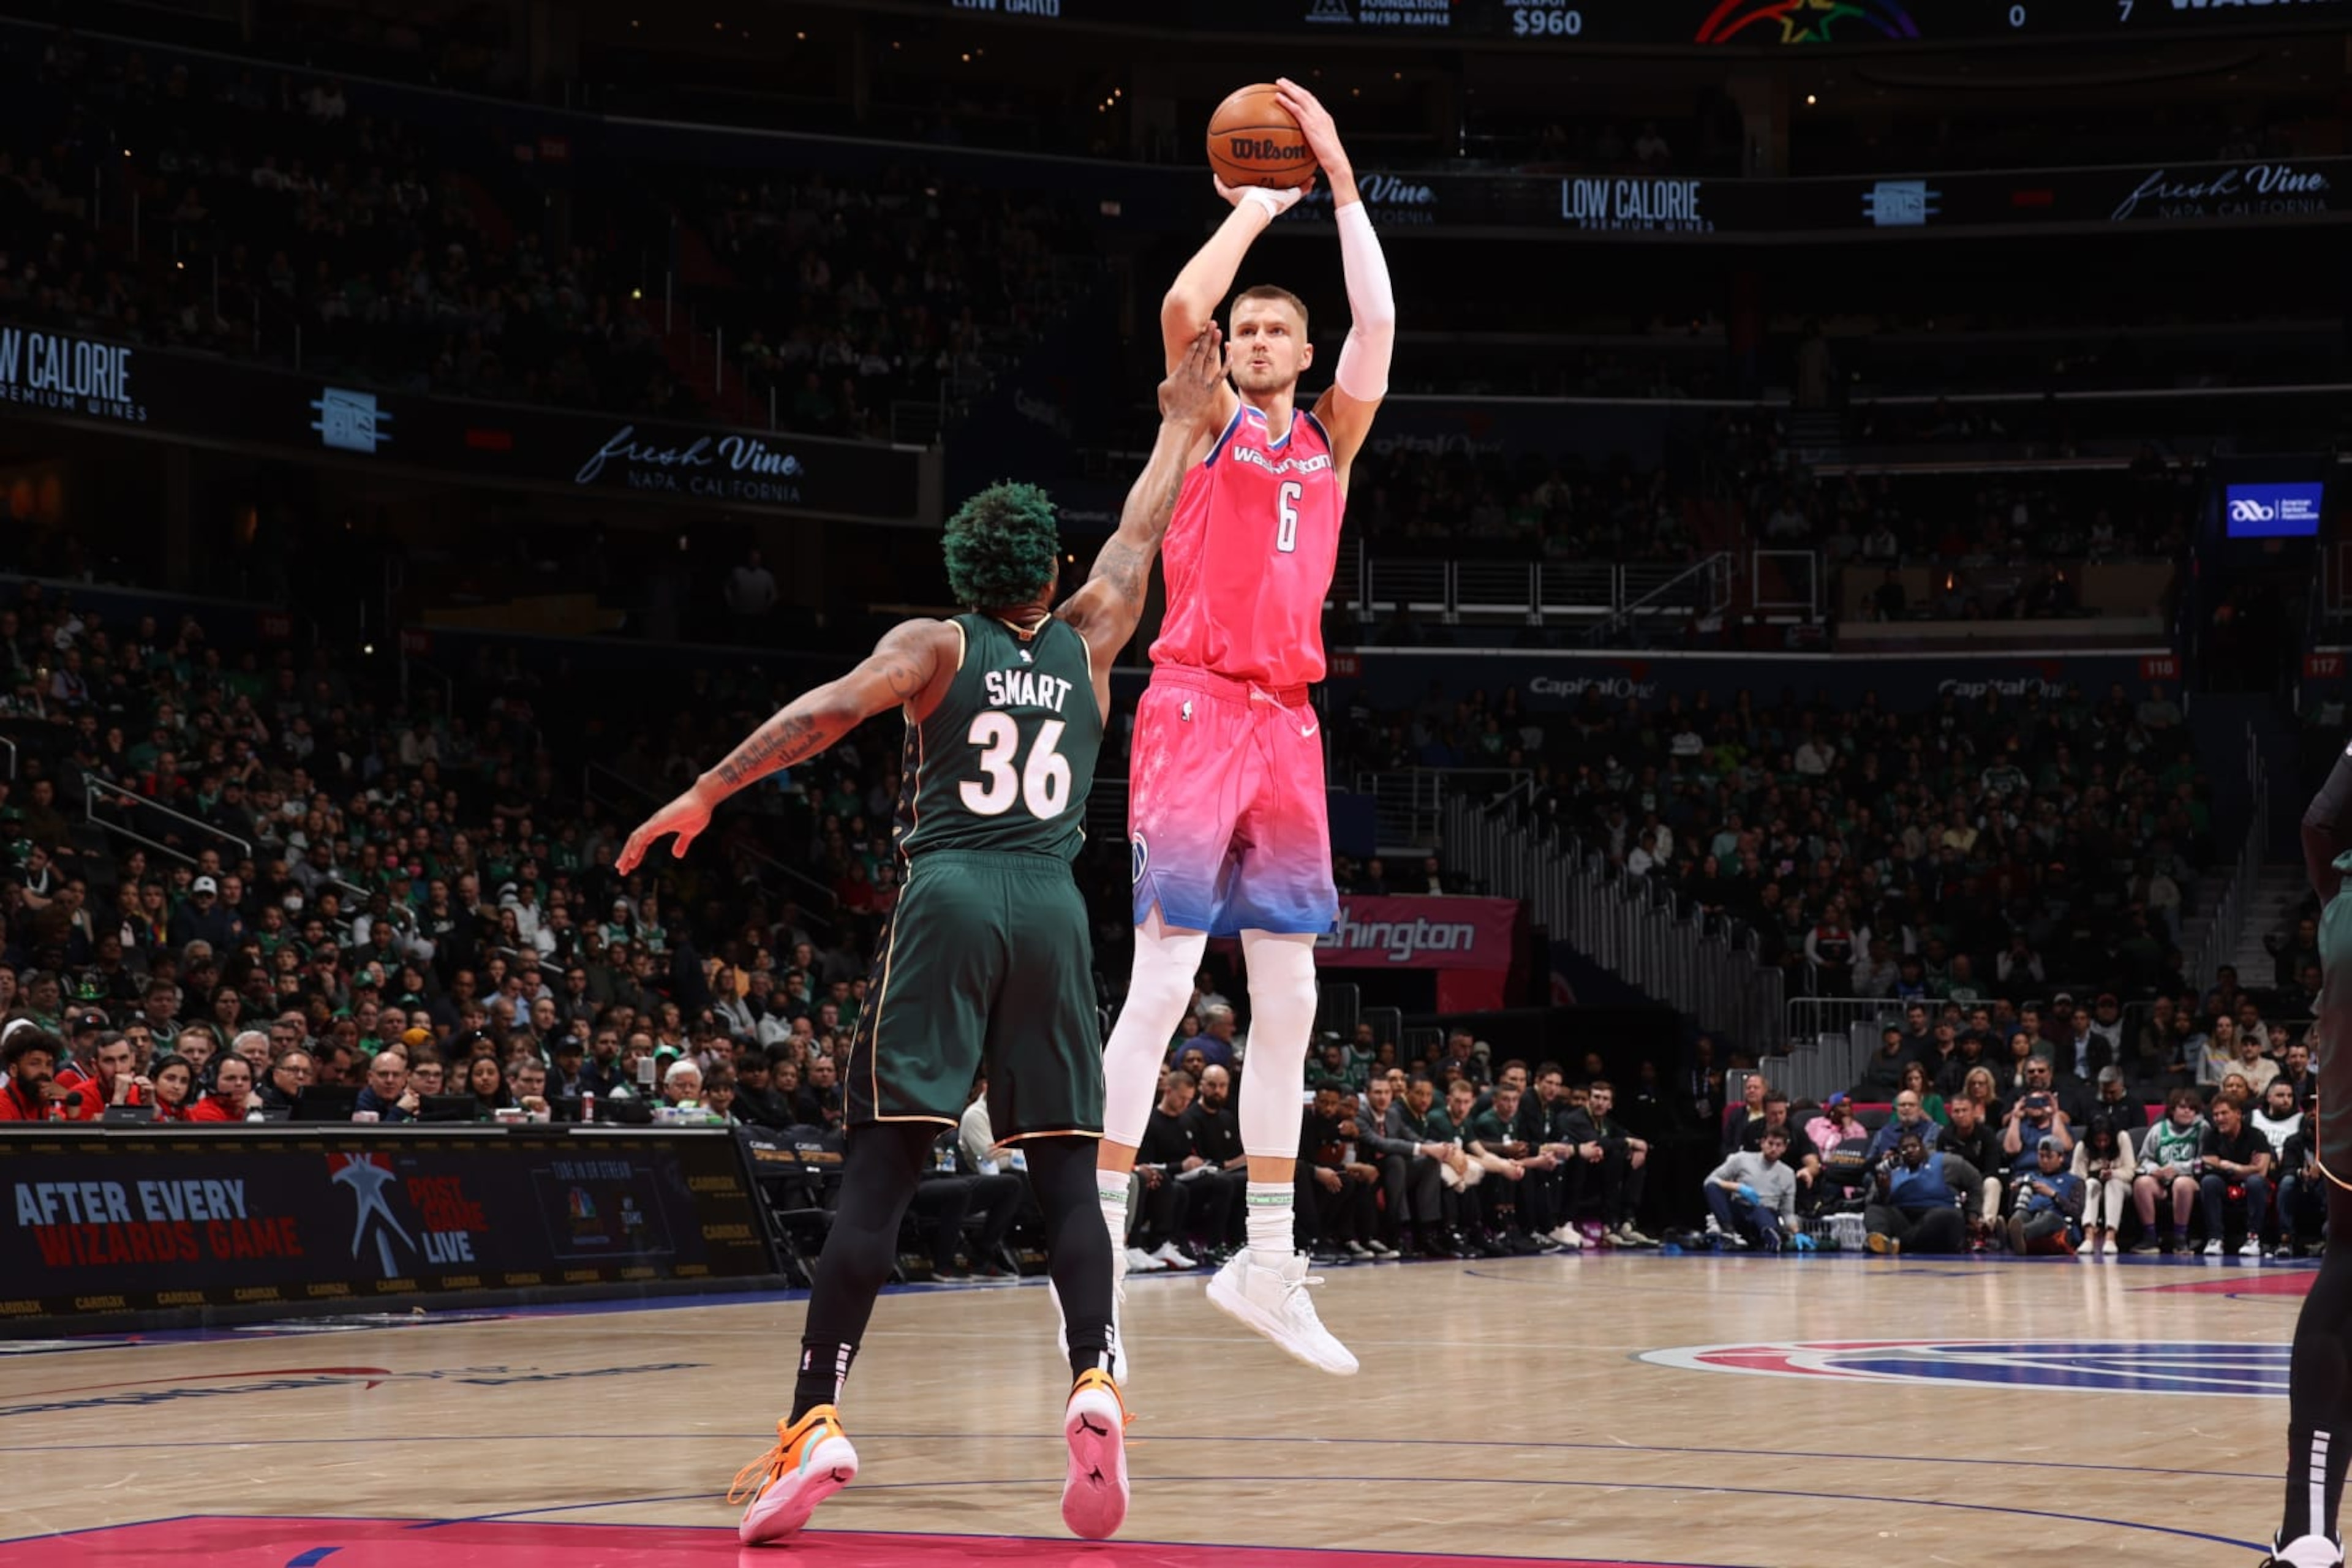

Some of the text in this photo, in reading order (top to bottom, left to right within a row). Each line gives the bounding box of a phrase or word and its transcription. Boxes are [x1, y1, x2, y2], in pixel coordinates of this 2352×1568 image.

[1512, 9, 1582, 37] $960
[2008, 5, 2027, 28] 0
[1230, 138, 1306, 159] Wilson
[1561, 178, 1702, 221] LOW CALORIE
[27, 331, 132, 404] CALORIE
[574, 424, 801, 485] fresh Vine
[1233, 445, 1332, 475] Washington
[1276, 481, 1302, 553] 6
[984, 669, 1072, 713] SMART
[958, 710, 1072, 821] 36
[1317, 905, 1475, 961] hington
[14, 1178, 249, 1226] AFTER EVERY
[32, 1215, 304, 1268] WIZARDS GAME
[420, 1230, 477, 1264] LIVE
